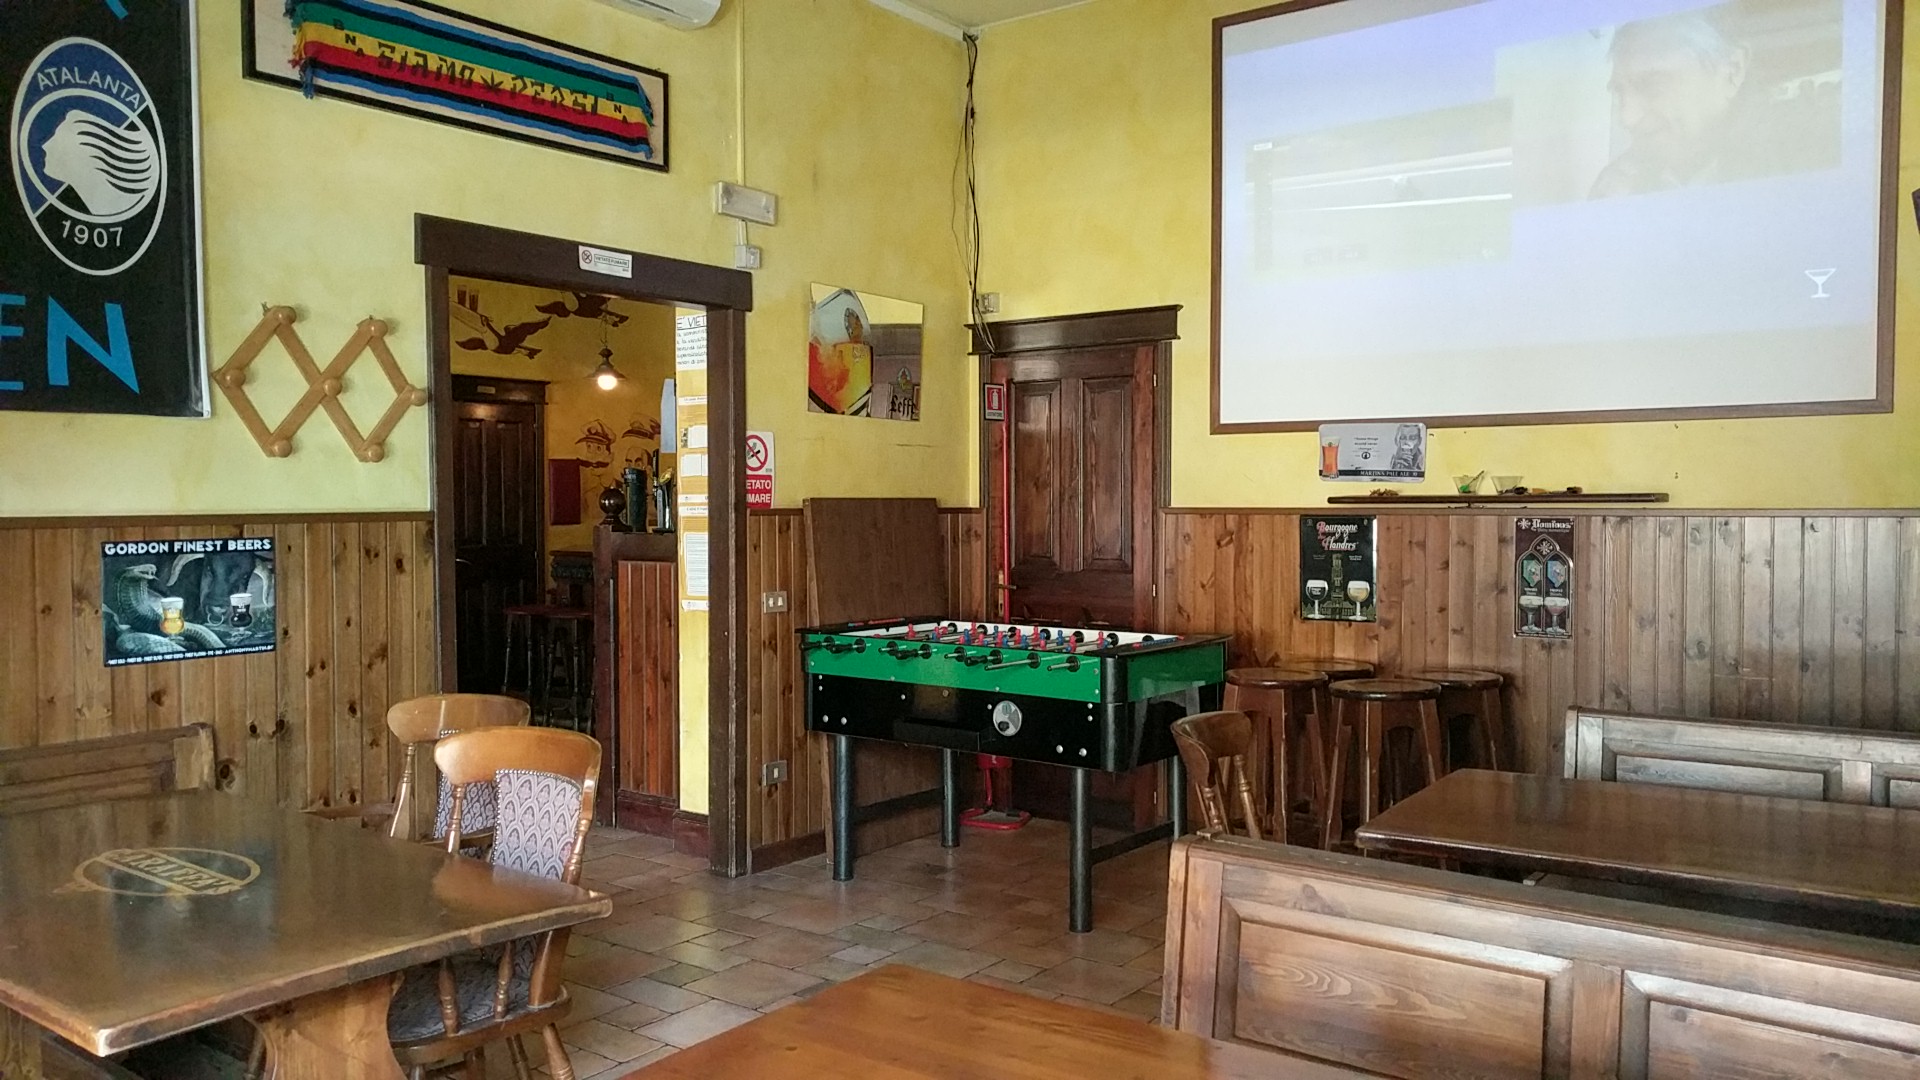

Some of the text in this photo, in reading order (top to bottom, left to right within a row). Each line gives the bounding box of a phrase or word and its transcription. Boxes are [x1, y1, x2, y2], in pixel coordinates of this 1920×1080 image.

[377, 41, 475, 89] SIAMO
[37, 66, 141, 109] ATALANTA
[61, 219, 123, 248] 1907
[687, 315, 706, 327] VIET
[746, 479, 772, 490] ETATO
[746, 493, 771, 504] MARE
[1316, 521, 1358, 538] Bourgogne
[104, 538, 272, 555] GORDON FINEST BEERS
